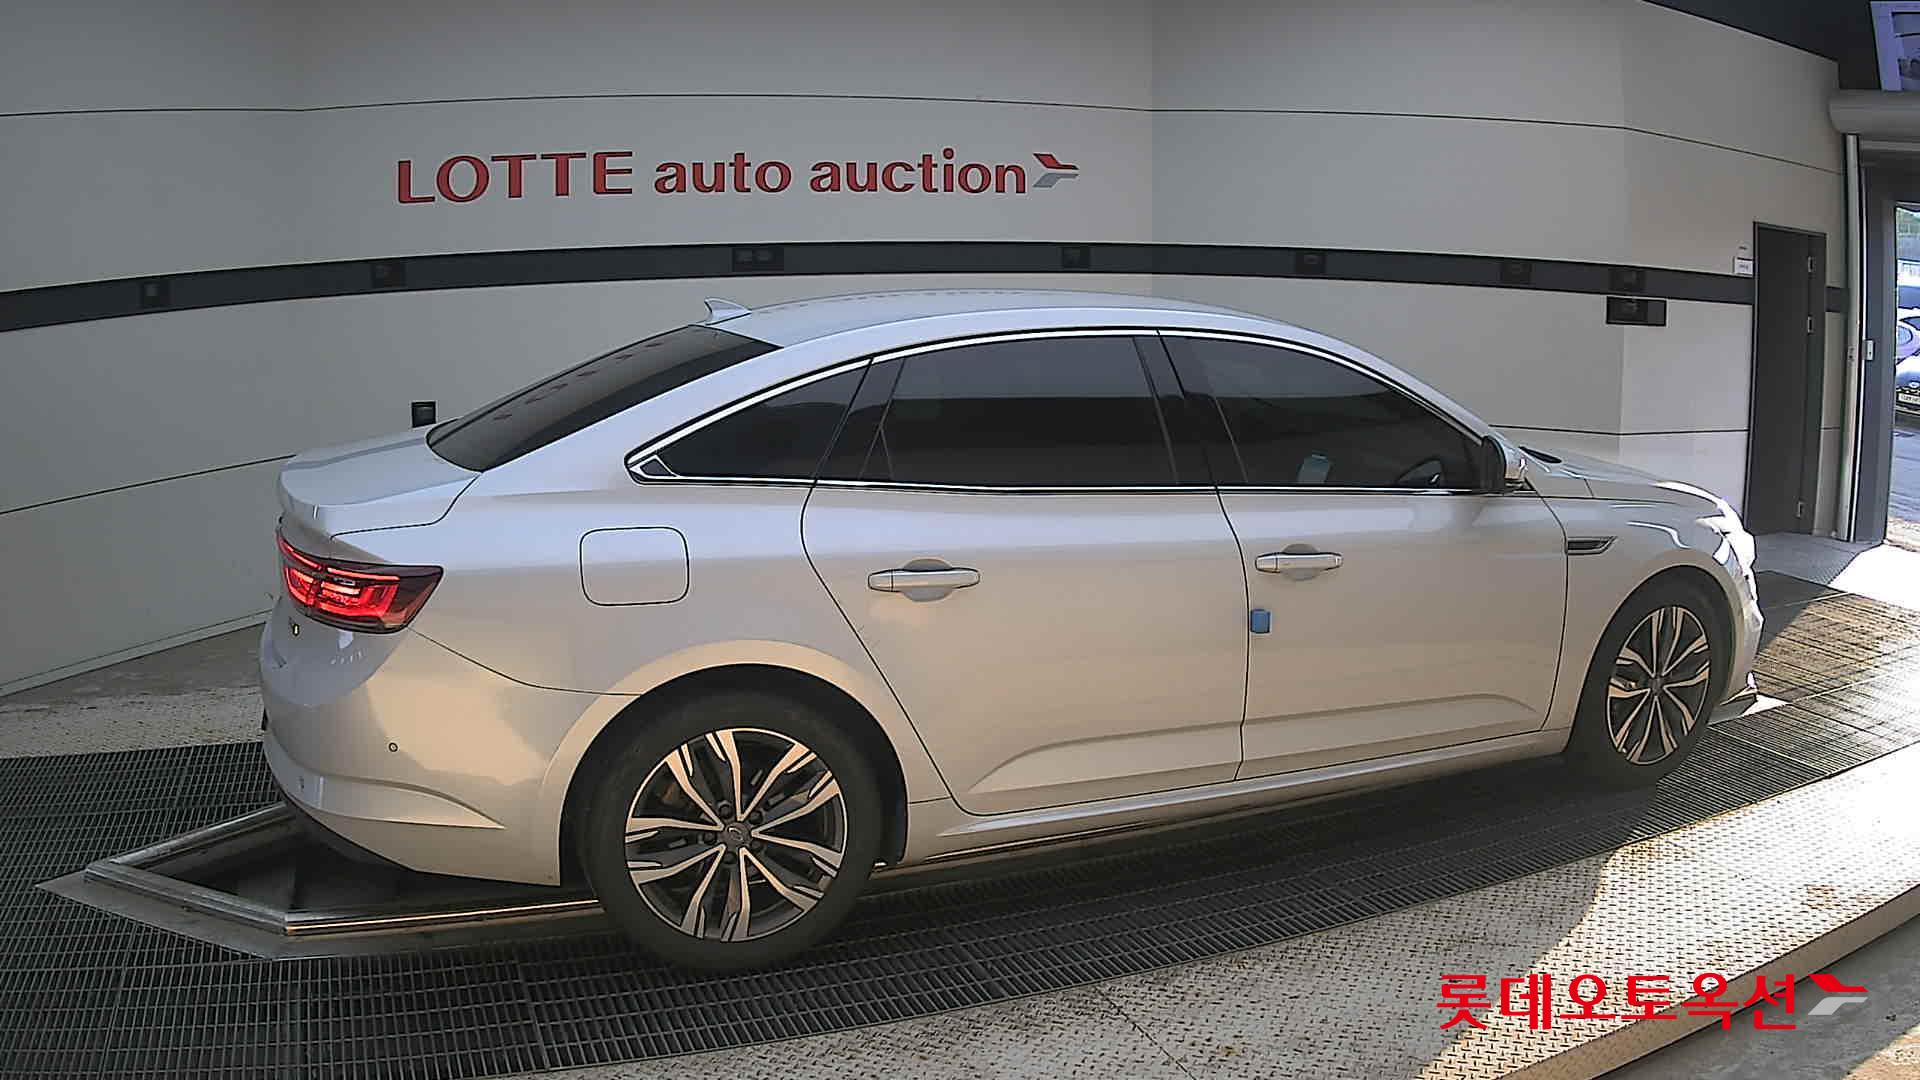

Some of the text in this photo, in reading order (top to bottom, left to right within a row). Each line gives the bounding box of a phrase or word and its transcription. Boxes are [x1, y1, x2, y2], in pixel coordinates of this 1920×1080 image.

[398, 148, 1027, 204] LOTTE auto auction
